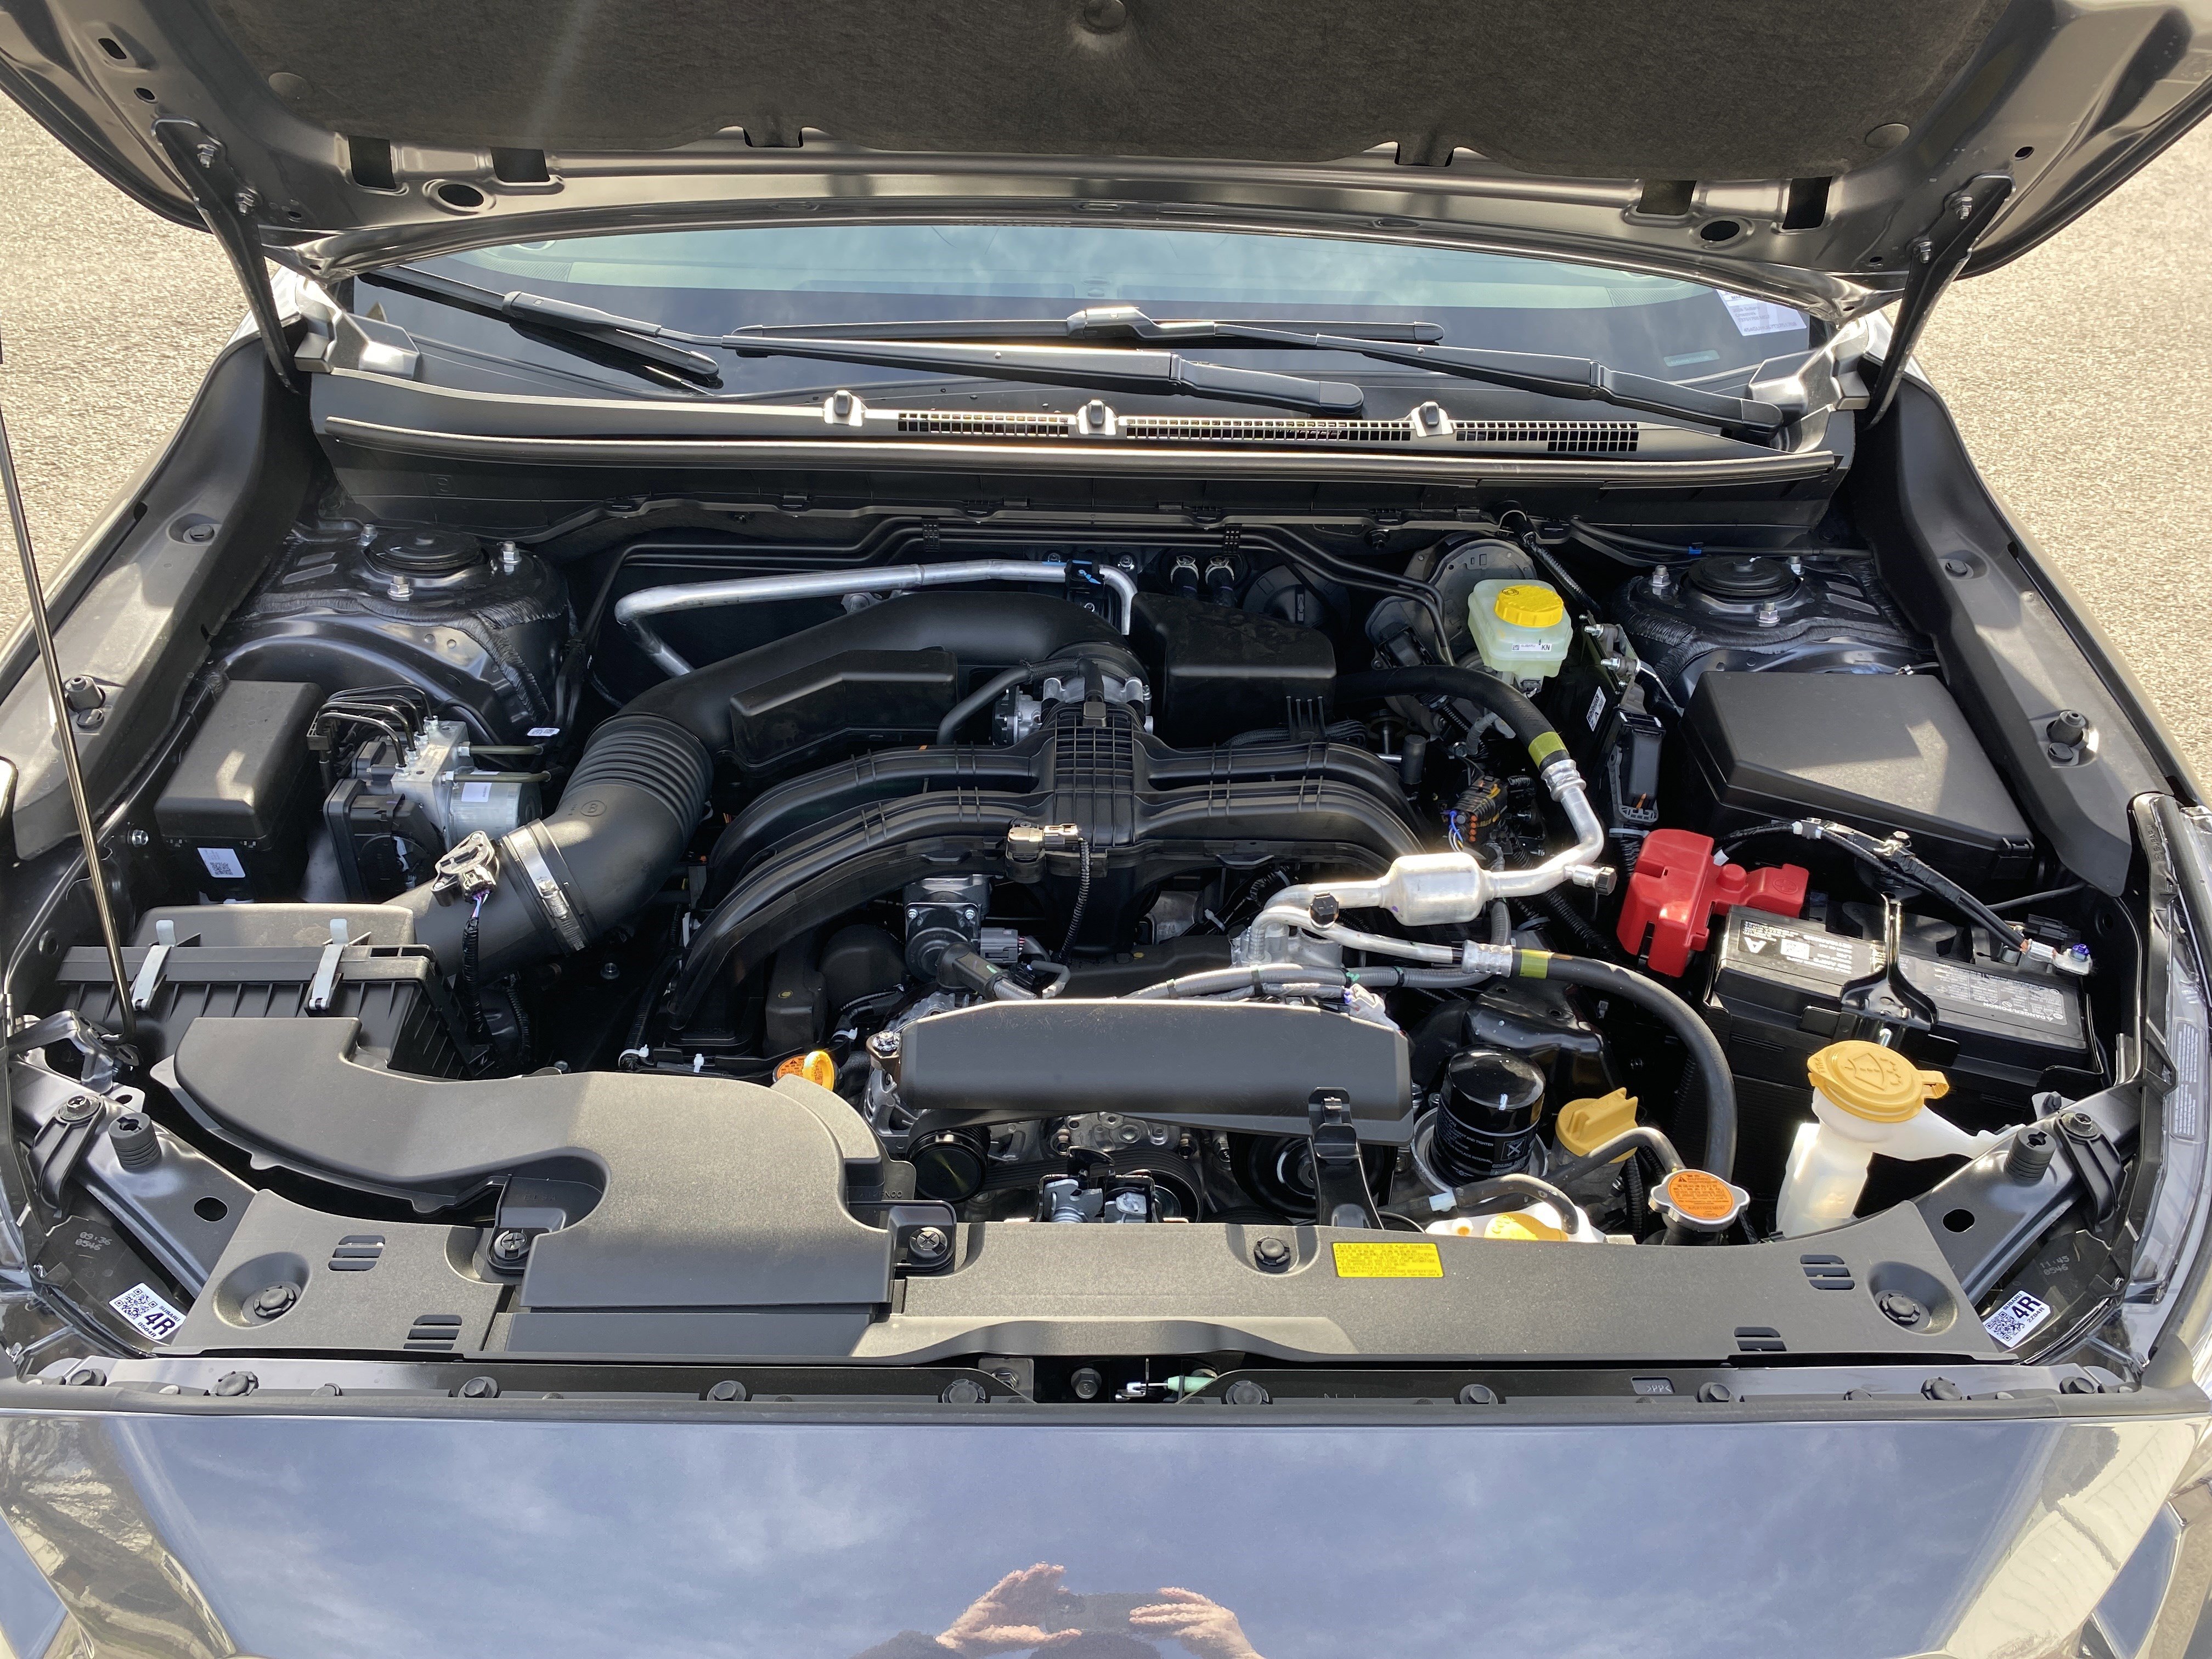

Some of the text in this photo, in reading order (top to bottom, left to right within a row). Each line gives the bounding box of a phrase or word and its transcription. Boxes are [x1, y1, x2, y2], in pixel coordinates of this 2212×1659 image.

[588, 803, 598, 813] B
[2146, 825, 2160, 851] SUBARU
[2003, 1293, 2022, 1311] SUBARU
[2011, 1296, 2042, 1319] 4R
[159, 1305, 181, 1322] SUBARU
[144, 1312, 176, 1336] 4R
